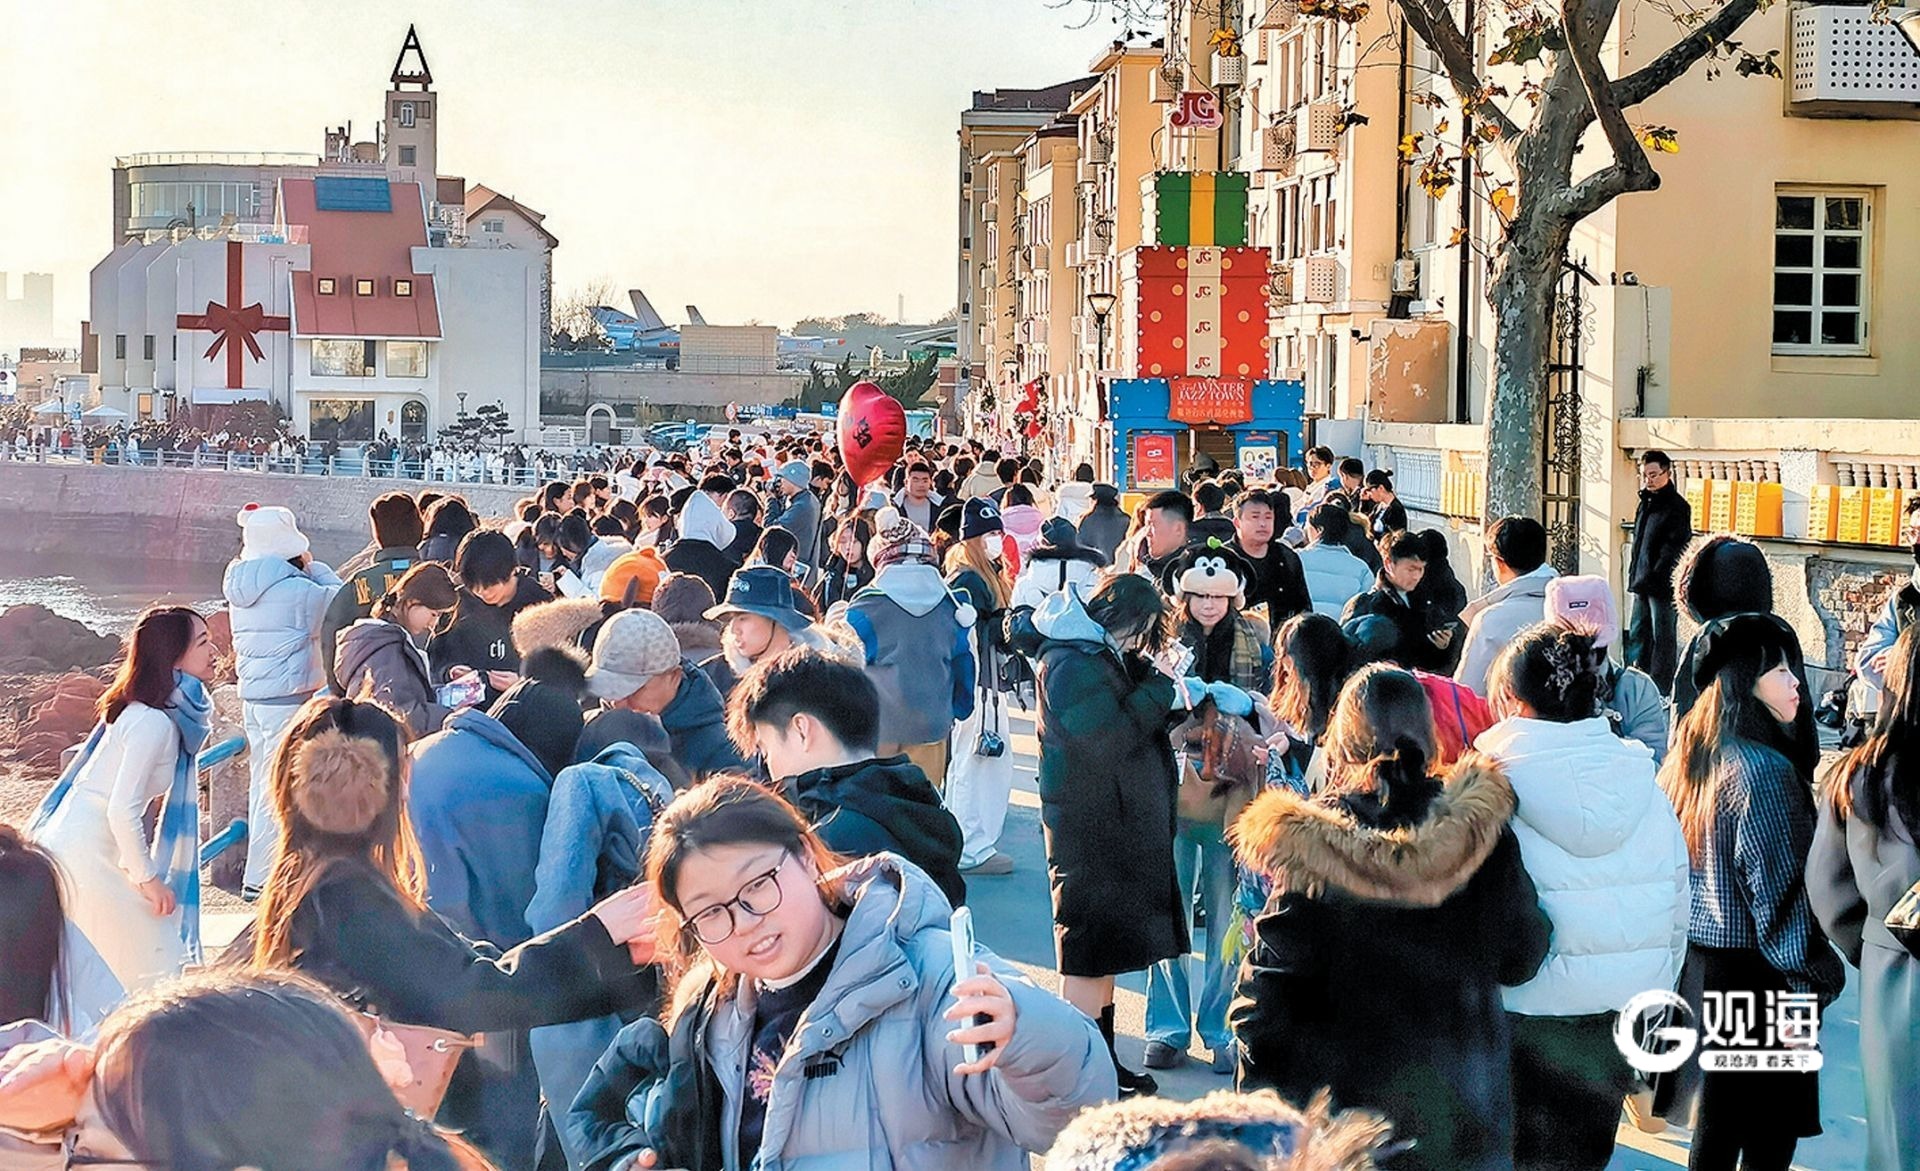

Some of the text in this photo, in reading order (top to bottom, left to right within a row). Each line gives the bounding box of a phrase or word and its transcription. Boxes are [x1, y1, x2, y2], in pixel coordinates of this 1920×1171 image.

[1197, 382, 1244, 392] WINTER
[1177, 391, 1245, 401] JAZZ TOWN
